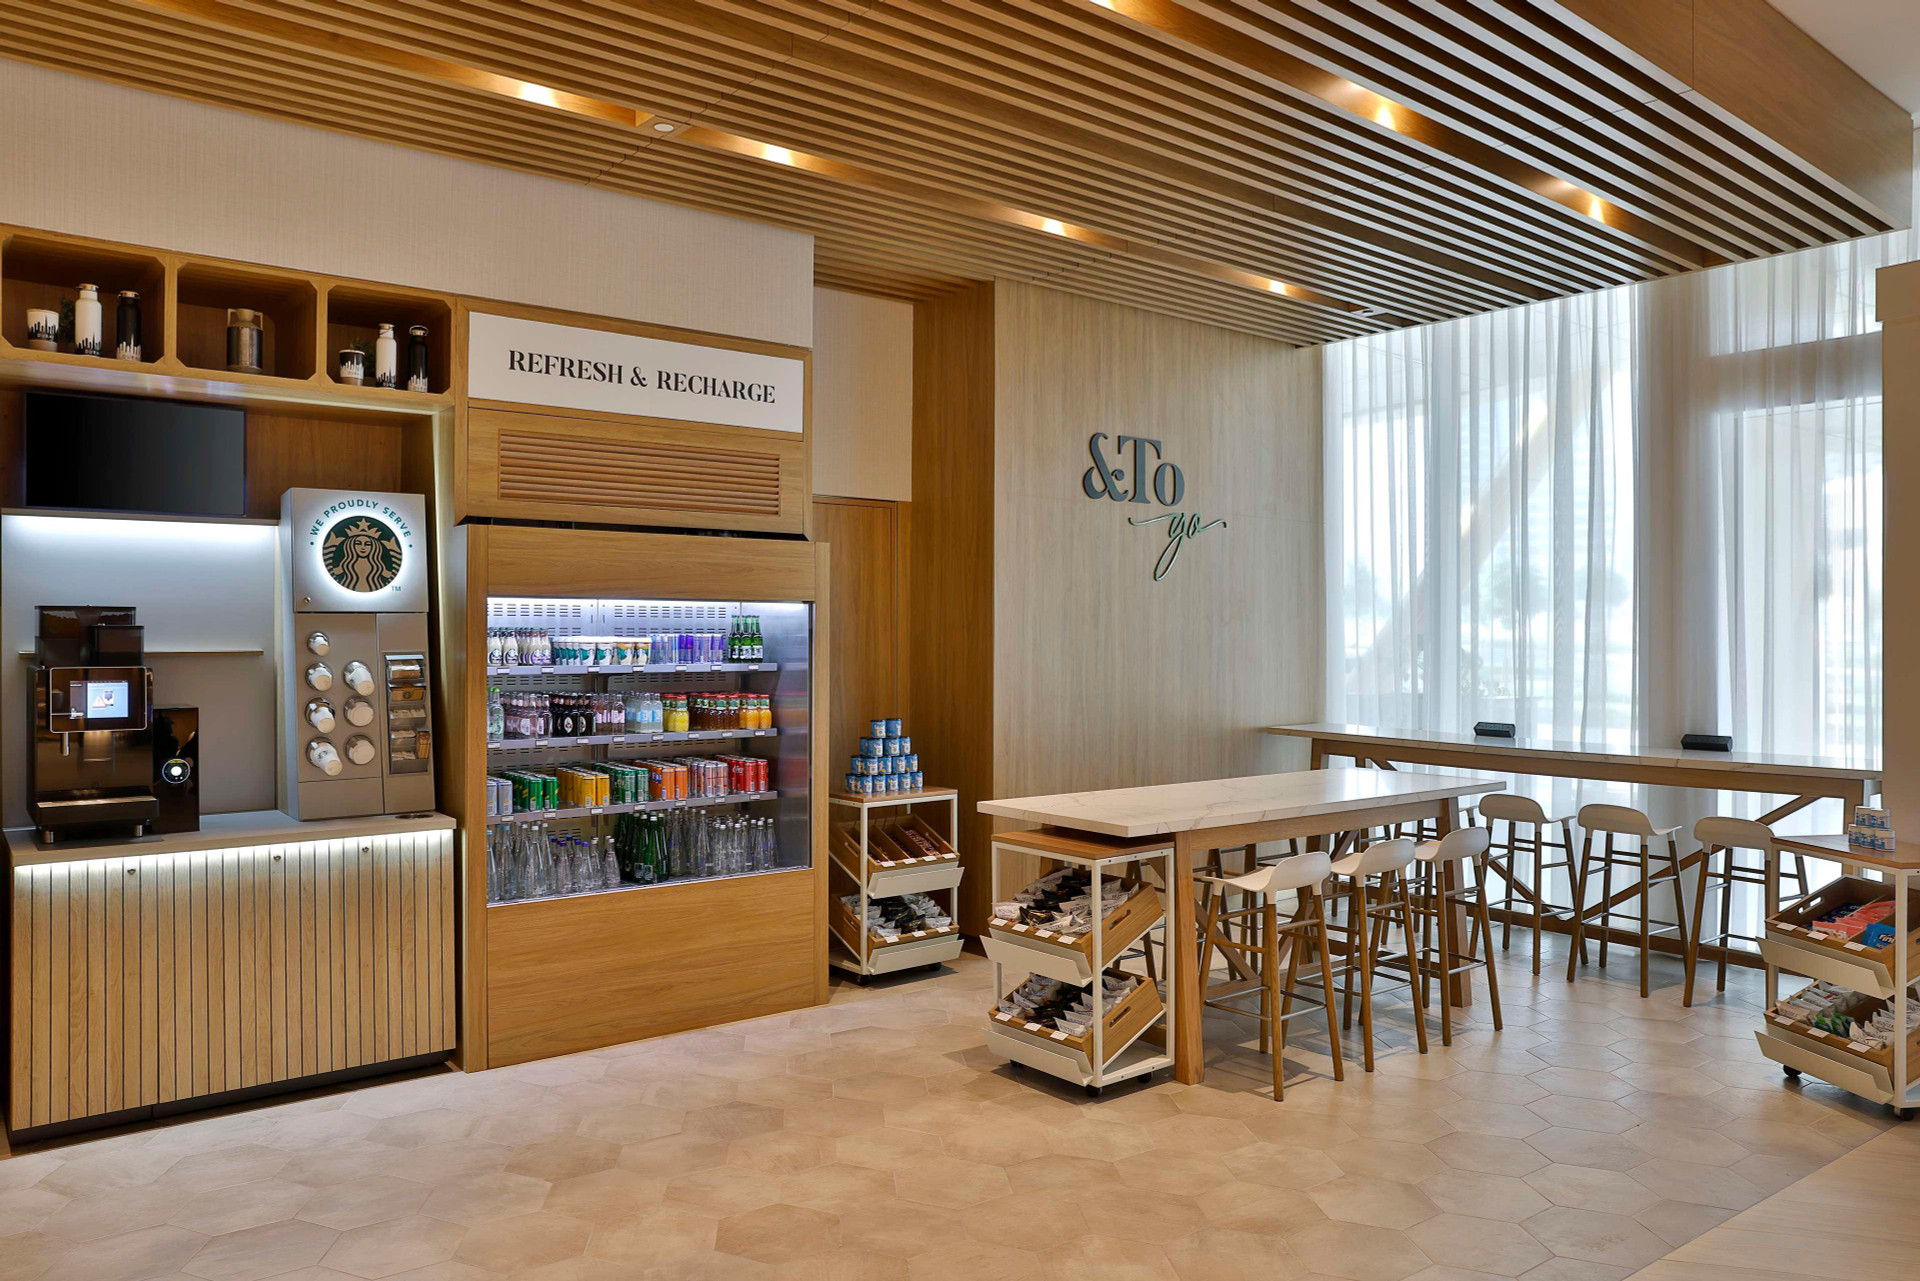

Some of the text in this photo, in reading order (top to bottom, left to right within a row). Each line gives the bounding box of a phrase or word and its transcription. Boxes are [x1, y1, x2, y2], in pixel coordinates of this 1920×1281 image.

[508, 350, 776, 404] REFRESH & RECHARGE
[310, 499, 411, 537] WE PROUDLY SERVE
